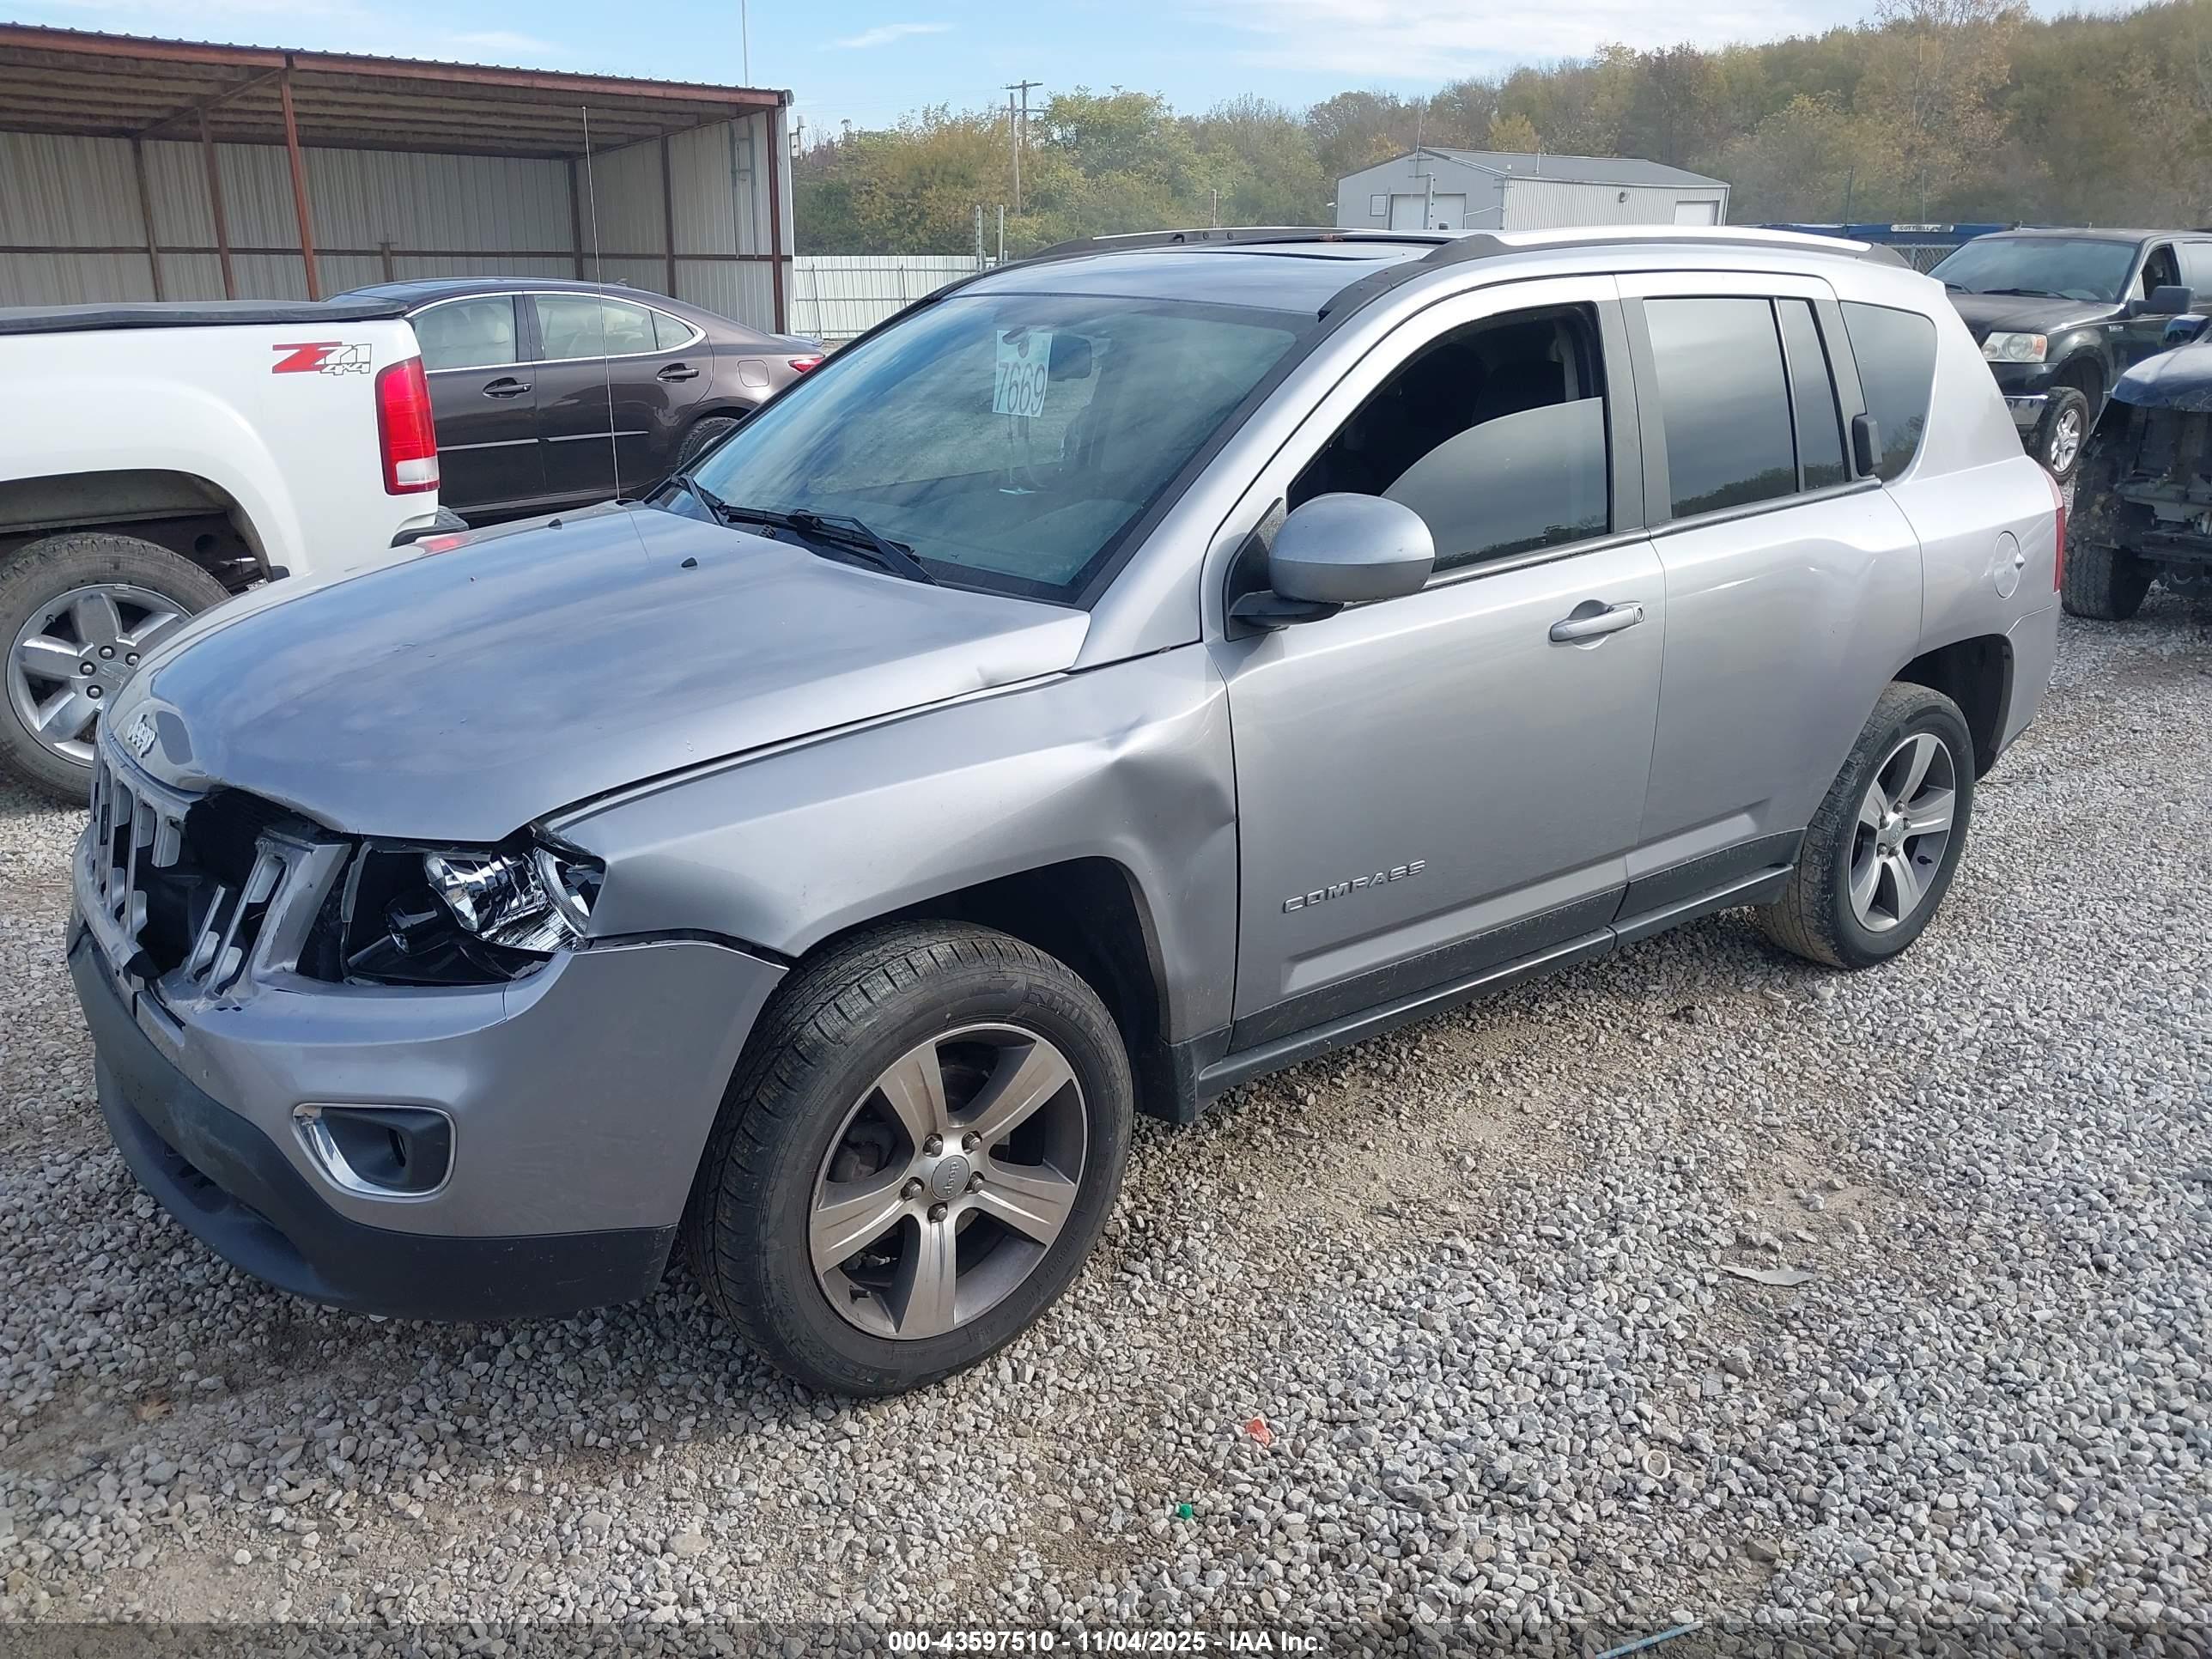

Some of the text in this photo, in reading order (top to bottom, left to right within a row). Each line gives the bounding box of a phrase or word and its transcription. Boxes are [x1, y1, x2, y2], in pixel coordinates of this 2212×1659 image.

[272, 342, 372, 374] Z71
[996, 362, 1046, 416] 7669
[1282, 860, 1426, 914] COMPASS
